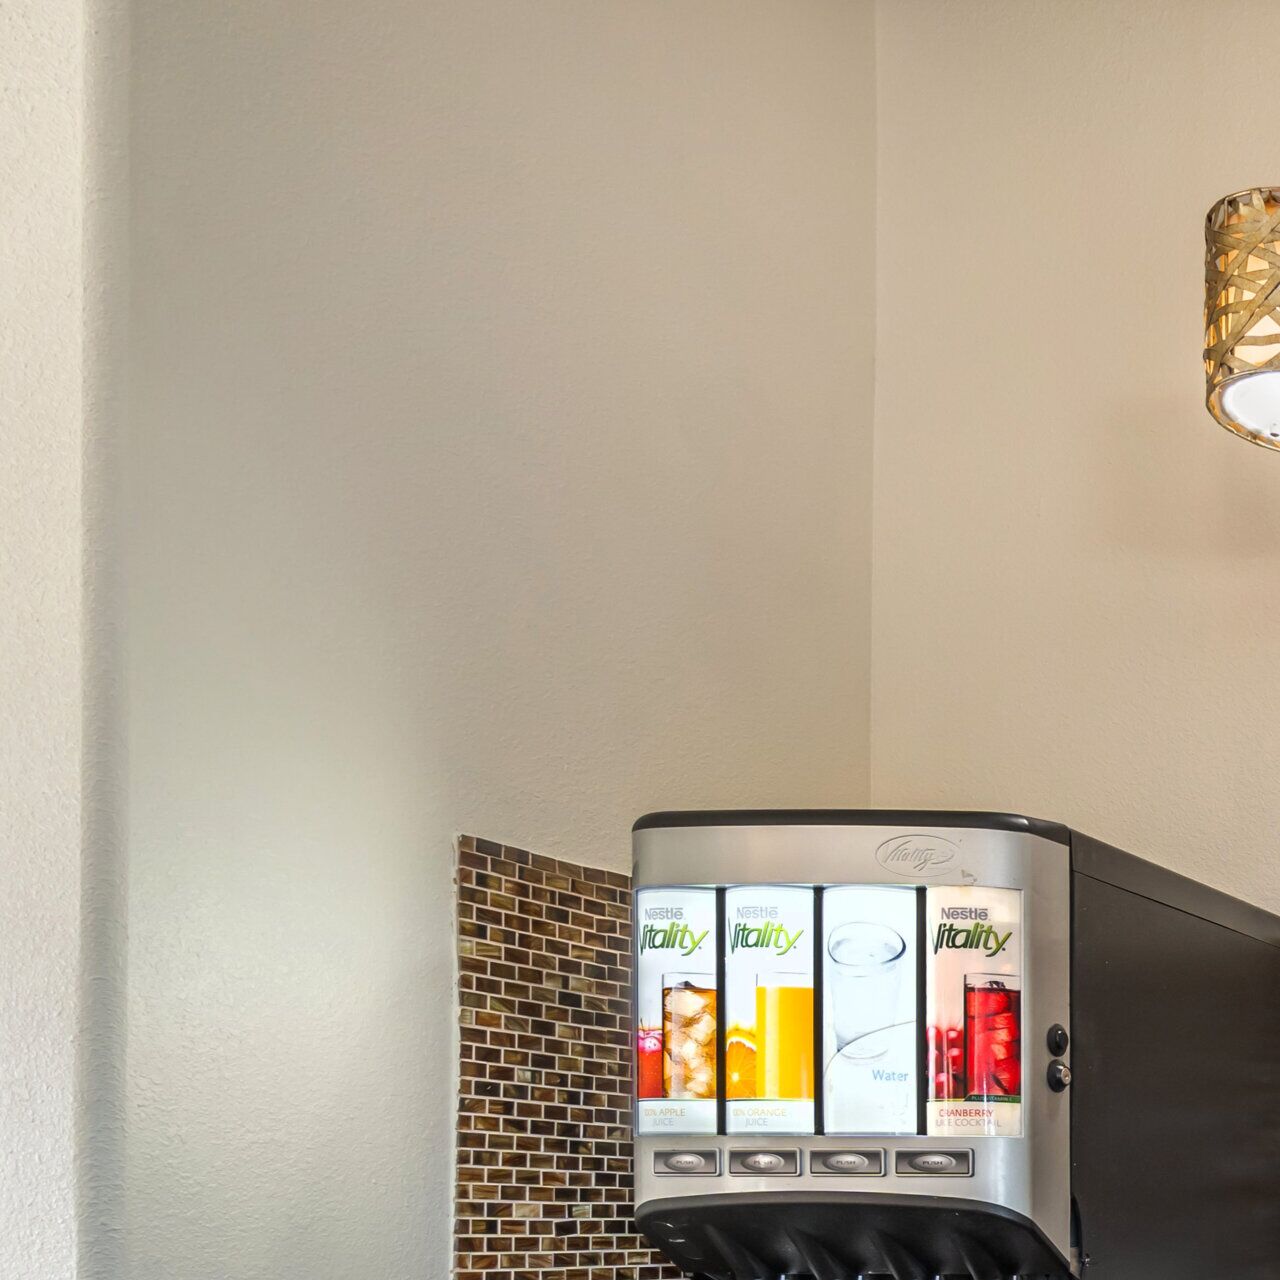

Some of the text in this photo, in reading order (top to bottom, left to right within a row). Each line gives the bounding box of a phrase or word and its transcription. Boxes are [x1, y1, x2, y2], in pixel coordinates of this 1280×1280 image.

[728, 916, 804, 956] Vitality
[930, 919, 1013, 958] Vitality
[872, 1069, 909, 1082] Water
[659, 1108, 686, 1117] APPLE
[747, 1108, 787, 1117] ORANGE
[745, 1118, 768, 1127] JUICE
